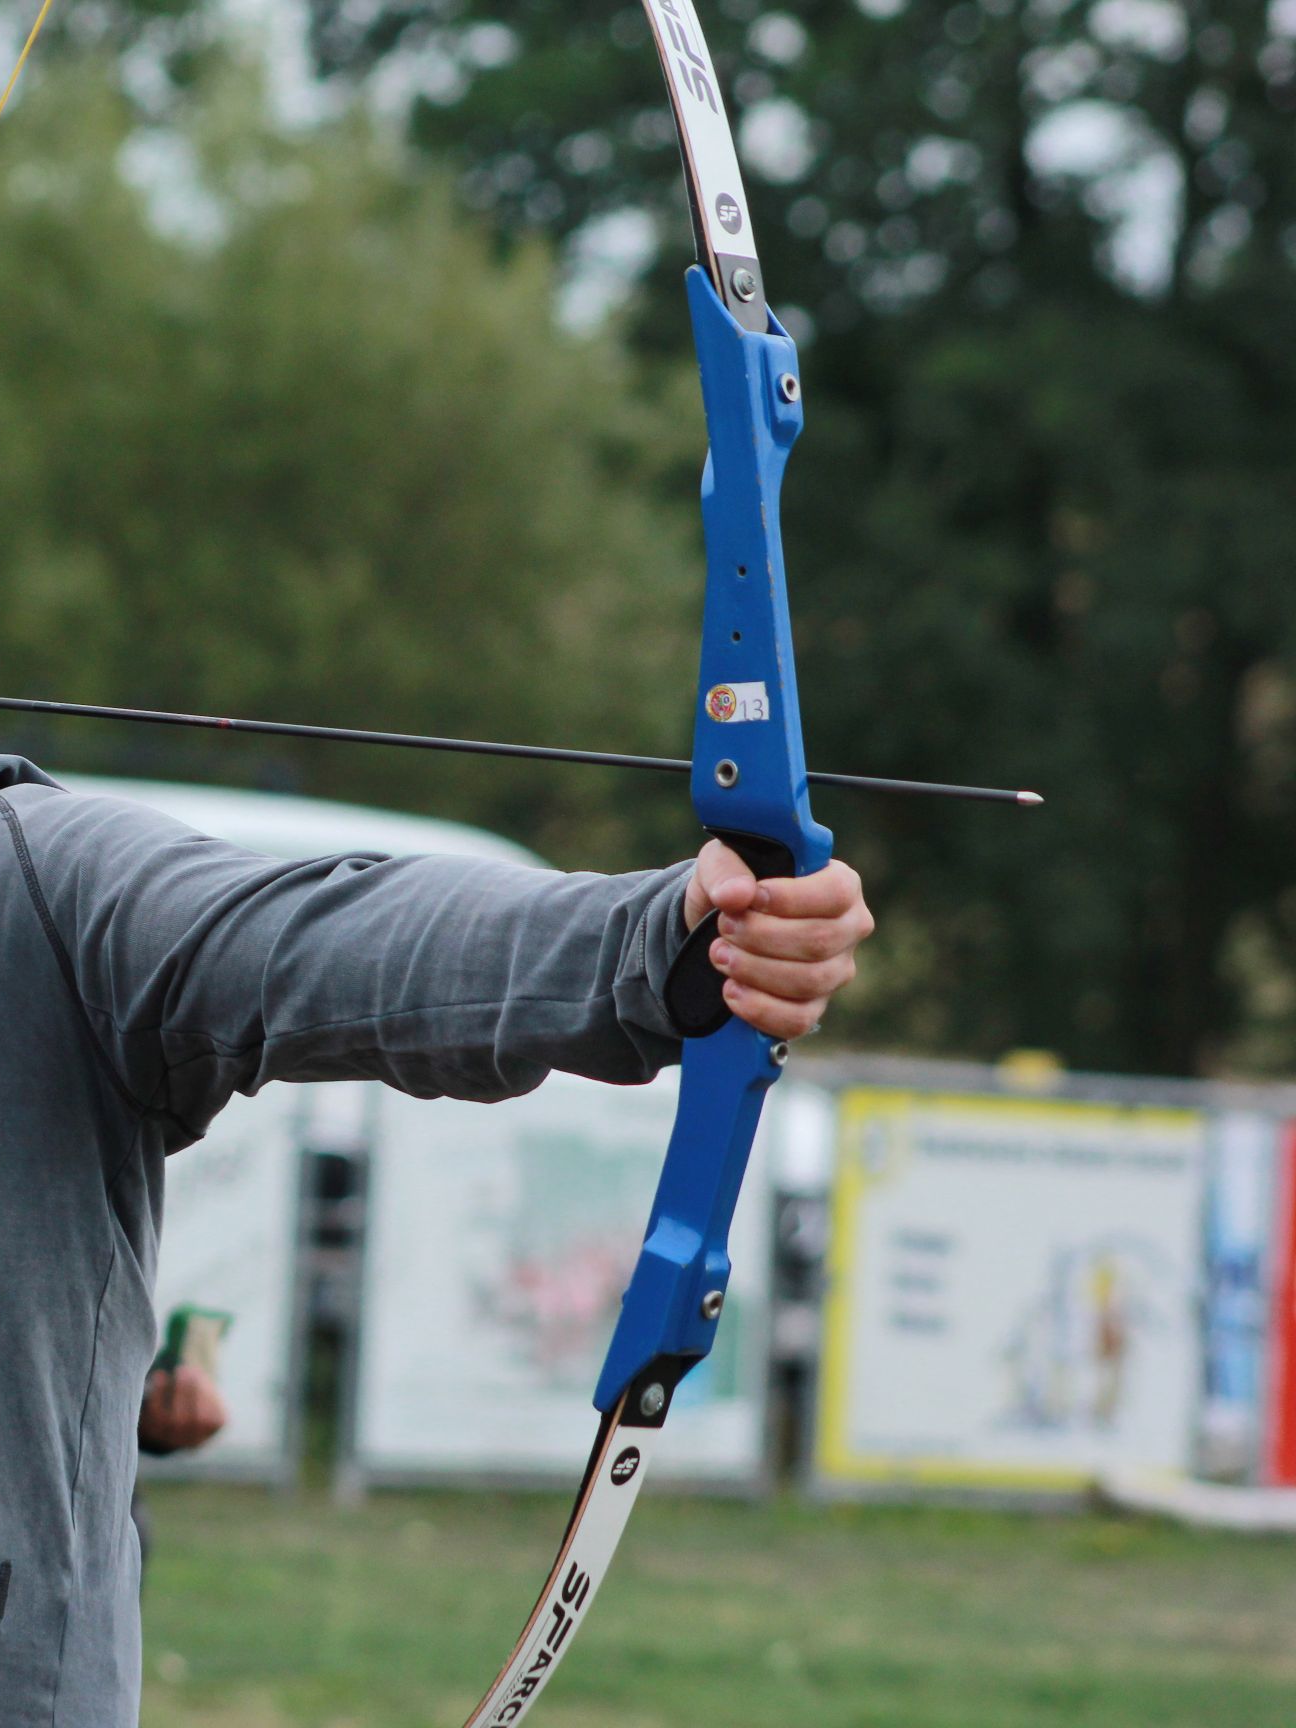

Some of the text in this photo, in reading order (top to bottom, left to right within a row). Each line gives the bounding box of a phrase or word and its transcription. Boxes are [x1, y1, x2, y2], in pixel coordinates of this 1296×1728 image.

[720, 205, 738, 222] SF
[739, 698, 764, 721] 13
[612, 1457, 639, 1475] SF
